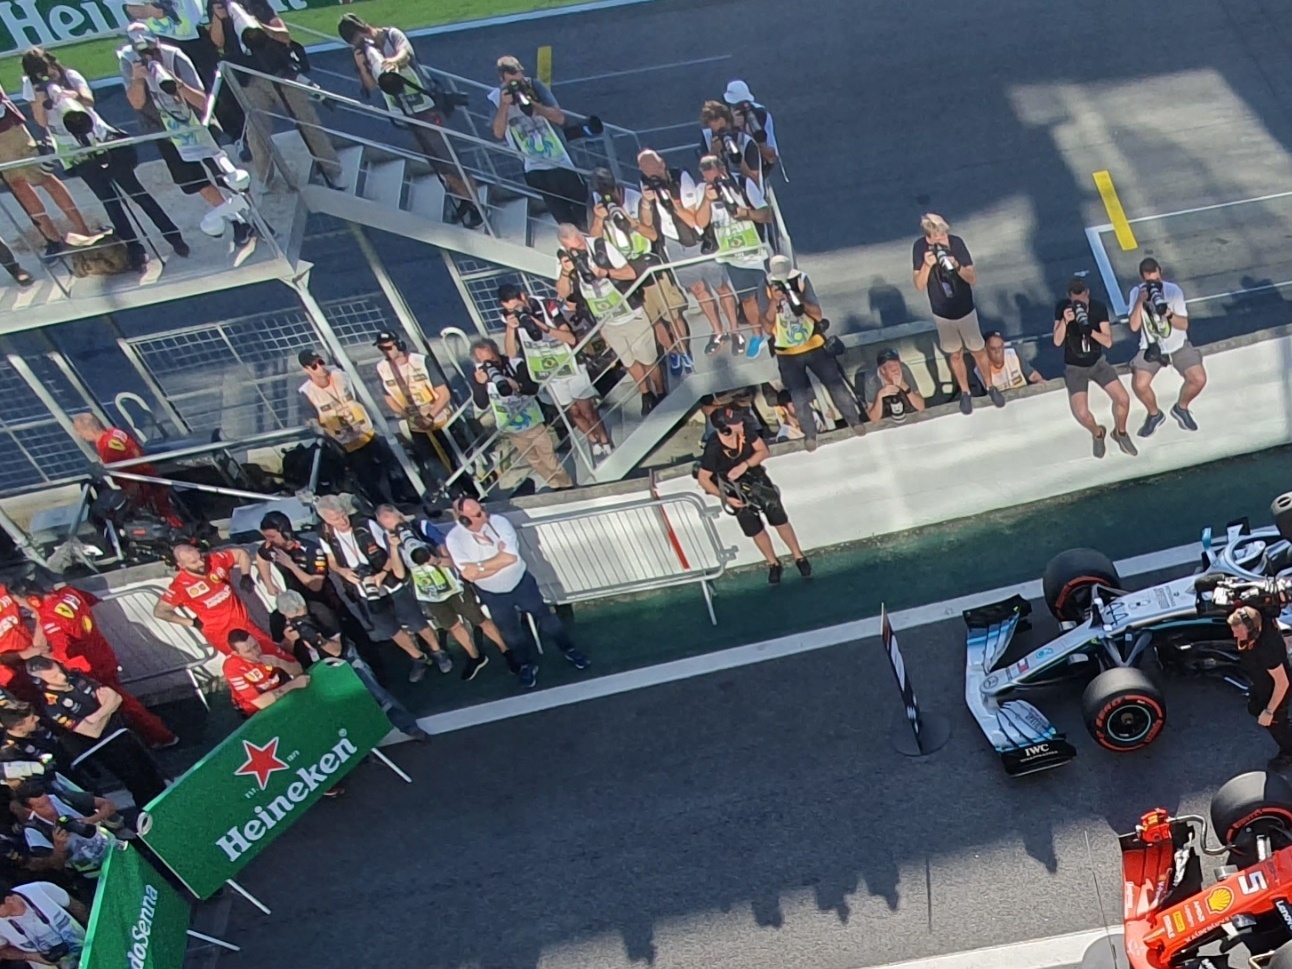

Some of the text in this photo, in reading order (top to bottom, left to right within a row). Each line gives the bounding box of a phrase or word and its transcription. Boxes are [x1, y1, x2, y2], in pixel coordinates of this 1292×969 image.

[1024, 743, 1050, 757] IWC
[215, 735, 358, 862] Heineken
[1237, 871, 1268, 896] 5
